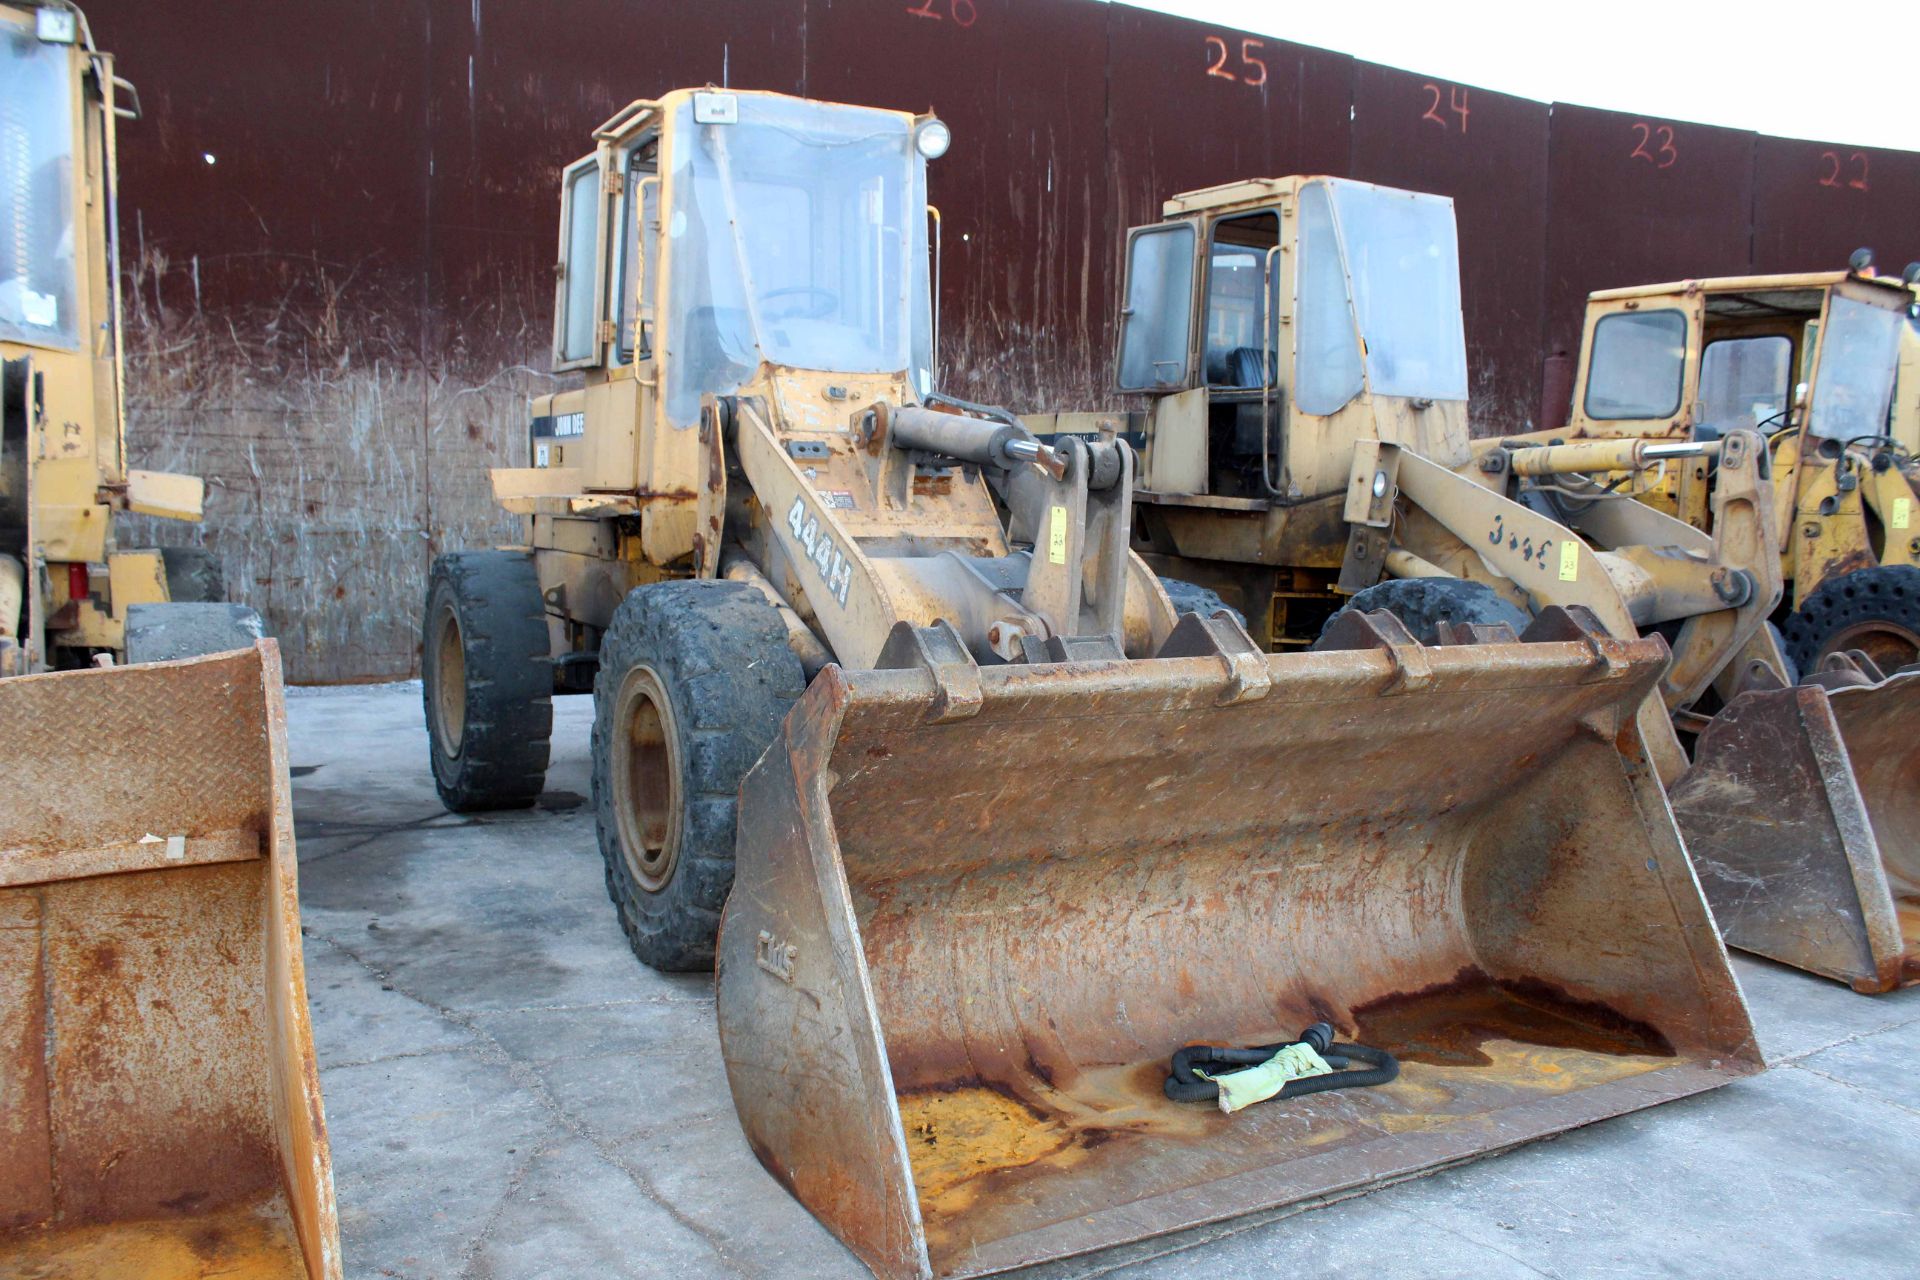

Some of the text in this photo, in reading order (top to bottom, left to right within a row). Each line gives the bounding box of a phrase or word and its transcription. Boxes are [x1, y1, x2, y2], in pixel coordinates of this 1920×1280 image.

[1205, 36, 1268, 86] 25
[1422, 84, 1470, 132] 24
[1631, 122, 1678, 168] 23
[1819, 151, 1870, 191] 22
[555, 417, 572, 437] JOHN
[787, 495, 853, 609] 444H
